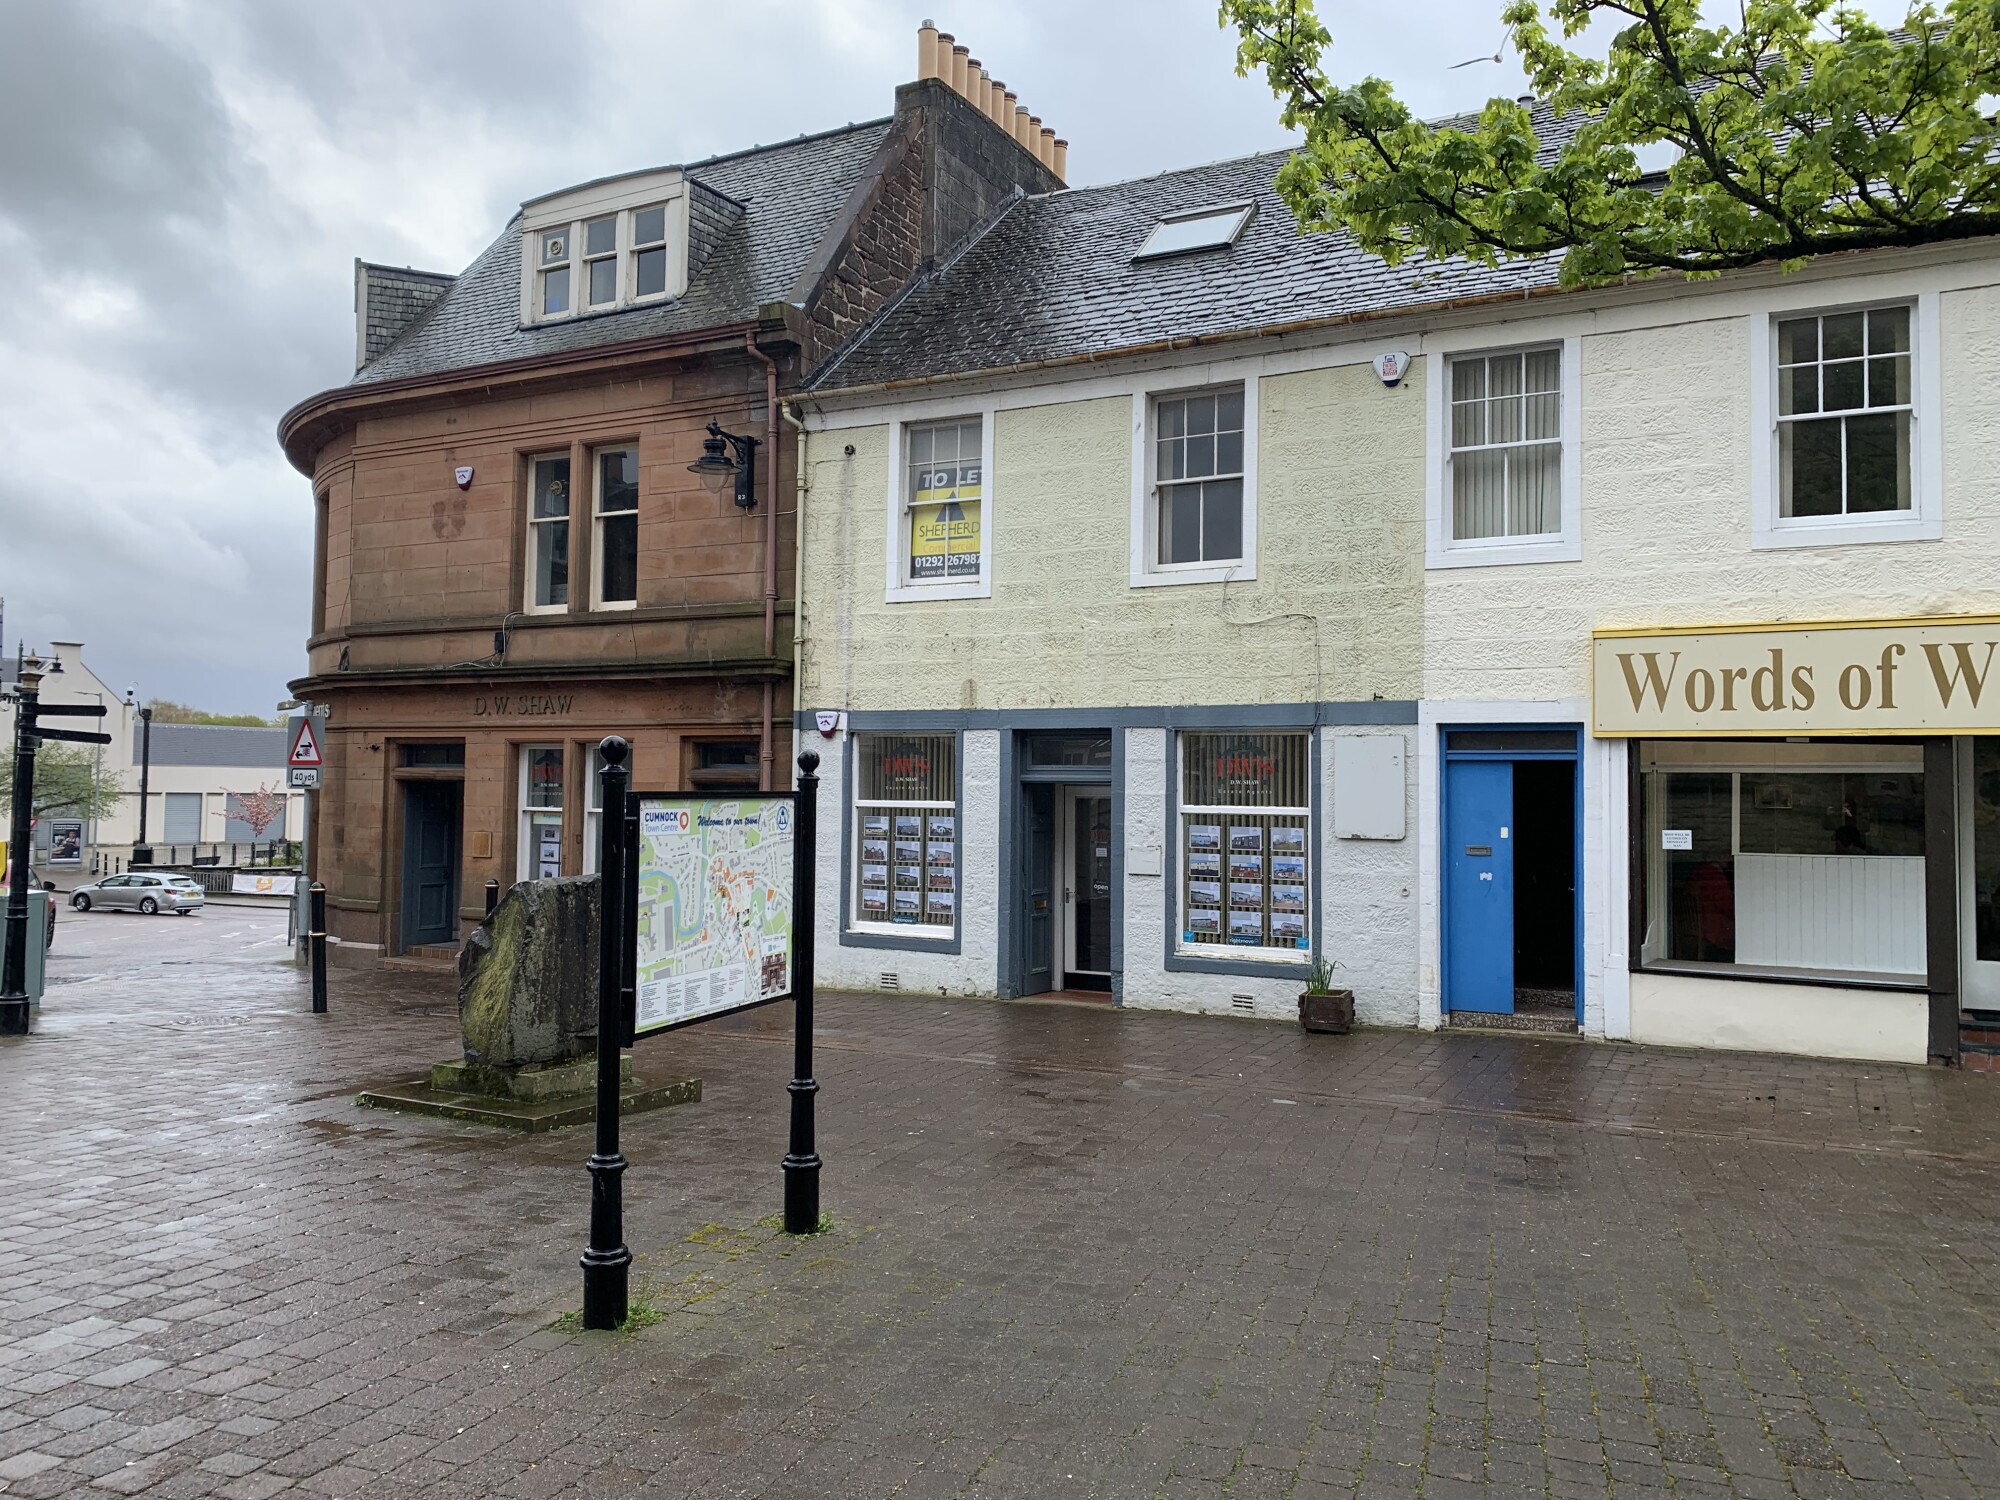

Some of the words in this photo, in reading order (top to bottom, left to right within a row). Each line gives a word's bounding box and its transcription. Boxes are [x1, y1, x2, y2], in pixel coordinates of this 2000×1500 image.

[923, 472, 947, 488] TO
[915, 555, 944, 568] 01292
[1616, 648, 1816, 714] Words
[1838, 643, 1906, 711] of
[518, 695, 574, 715] SHAW
[294, 772, 303, 781] 40
[304, 773, 315, 783] yds
[645, 812, 679, 823] CUMNOCK
[697, 815, 724, 827] Welcome
[725, 817, 732, 826] to
[645, 823, 660, 832] Town
[661, 823, 679, 832] Centre
